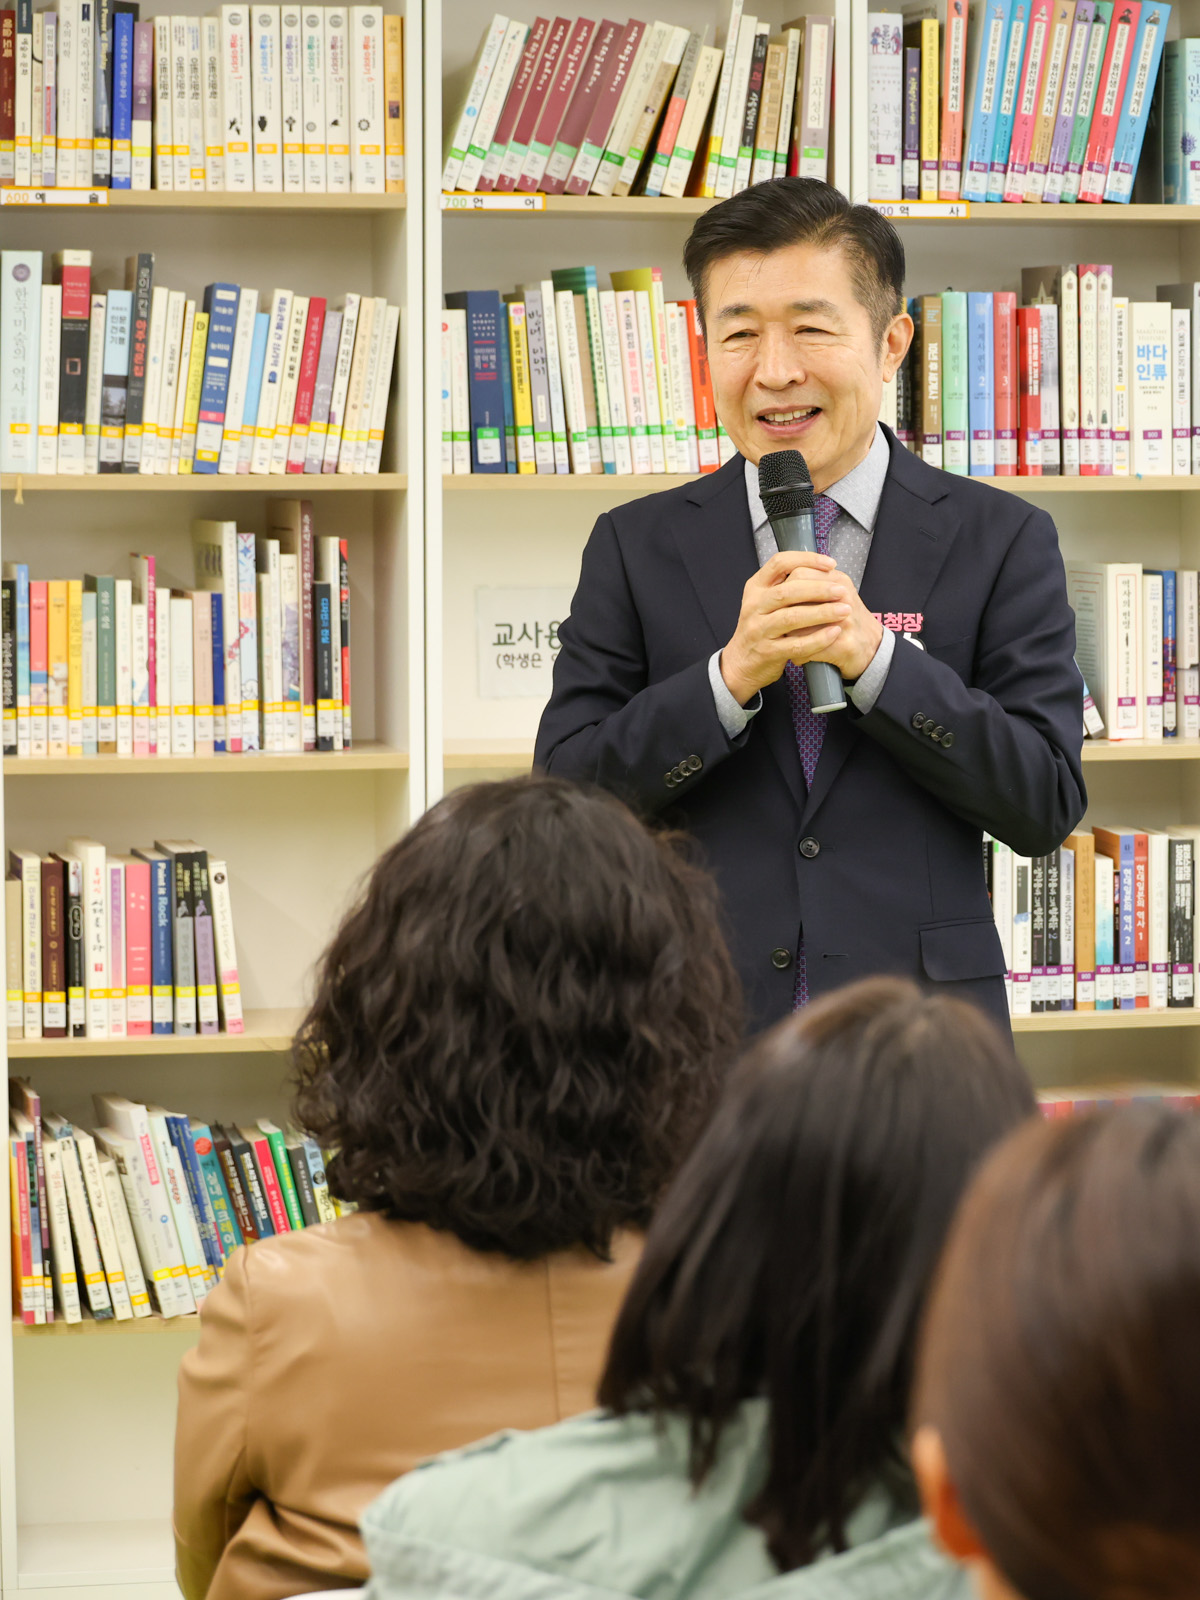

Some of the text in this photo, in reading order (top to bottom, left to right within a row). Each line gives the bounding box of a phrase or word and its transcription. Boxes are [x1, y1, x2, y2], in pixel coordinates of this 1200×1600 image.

[6, 192, 30, 203] 600
[445, 197, 467, 208] 700
[525, 198, 535, 209] 어
[900, 206, 910, 216] 역
[949, 206, 960, 217] 사
[1136, 344, 1168, 361] 바다
[1136, 363, 1168, 381] 인류
[928, 372, 939, 400] 세계사
[1136, 864, 1145, 908] 현대일본의
[1123, 868, 1133, 945] 현대일본의 역사 2
[1136, 911, 1145, 929] 역사
